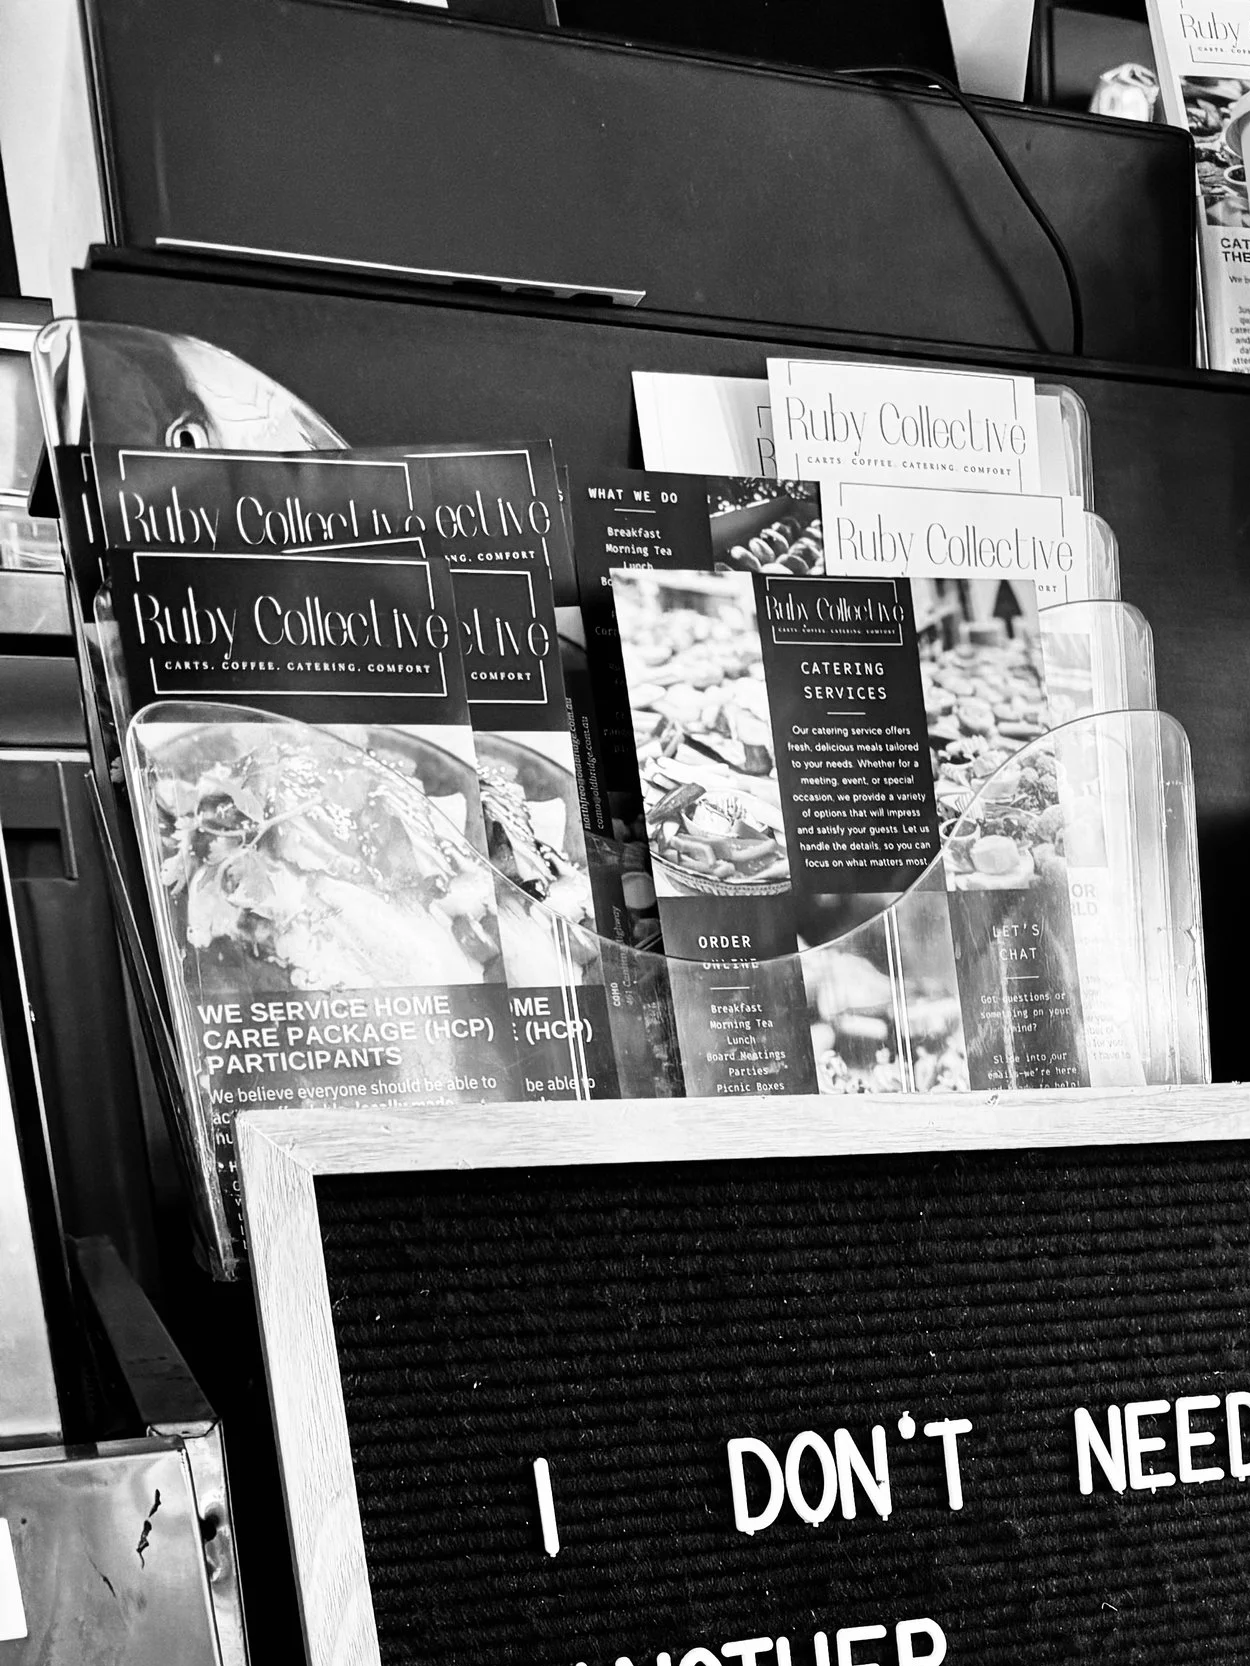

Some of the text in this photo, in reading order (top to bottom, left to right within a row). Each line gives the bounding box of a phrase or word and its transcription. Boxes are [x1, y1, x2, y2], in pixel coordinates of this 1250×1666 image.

[1180, 12, 1240, 47] Ruby
[786, 393, 1026, 456] Ruby Collective
[963, 466, 1011, 476] COMFORT
[588, 488, 678, 503] WHAT WE DO
[118, 485, 220, 551] Ruby
[607, 527, 661, 539] Breakfast
[605, 544, 672, 557] Morning Tea
[837, 513, 1073, 576] Ruby Collective
[477, 550, 536, 562] COMFORT
[766, 593, 904, 628] Ruby Collective
[133, 586, 449, 660] Ruby Collective
[367, 663, 431, 673] COMFORT
[800, 661, 885, 676] CATERING
[470, 671, 532, 681] COMFORT
[803, 686, 887, 700] SERVICES
[792, 725, 911, 737] Our catering service offers
[815, 743, 854, 752] delicious
[857, 743, 883, 752] meals
[885, 742, 919, 752] tailored
[791, 760, 801, 768] to
[803, 760, 823, 770] your
[857, 759, 895, 768] Whether
[899, 759, 911, 768] for
[883, 775, 915, 786] special
[837, 794, 850, 802] we
[853, 793, 886, 802] provide
[896, 793, 926, 802] variety
[802, 808, 921, 819] of options that will impress
[797, 824, 930, 836] and satisfy your Let us
[799, 842, 830, 851] handle
[832, 842, 847, 851] the
[897, 842, 913, 851] you
[915, 841, 931, 849] can
[805, 859, 830, 868] focus
[846, 858, 868, 867] what
[870, 858, 903, 867] matters
[992, 923, 1040, 938] LET'S
[698, 935, 751, 948] ORDER
[1000, 947, 1037, 961] CHAT
[980, 994, 999, 1004] Got
[197, 995, 450, 1025] WE SERVICE HOME
[711, 1003, 763, 1014] Breakfast
[1033, 1007, 1070, 1019] on your
[710, 1019, 773, 1030] Morning Tea
[203, 1017, 494, 1050] CARE PACKAGE (HCP)
[727, 1035, 756, 1045] Lunch
[206, 1046, 403, 1076] PARTICIPANTS
[706, 1050, 786, 1062] Board Meetings
[1026, 1053, 1047, 1062] into
[729, 1065, 769, 1077] Parties
[1055, 1066, 1077, 1074] here
[211, 1089, 234, 1105] We
[237, 1086, 294, 1103] believe
[297, 1083, 367, 1100] everyone
[371, 1079, 420, 1095] should
[424, 1077, 443, 1092] be
[447, 1076, 478, 1091] able
[481, 1075, 497, 1090] to
[525, 1076, 576, 1092] be able
[716, 1082, 785, 1093] Picnic Boxes
[534, 1458, 559, 1557] I
[728, 1411, 973, 1536] DON'T
